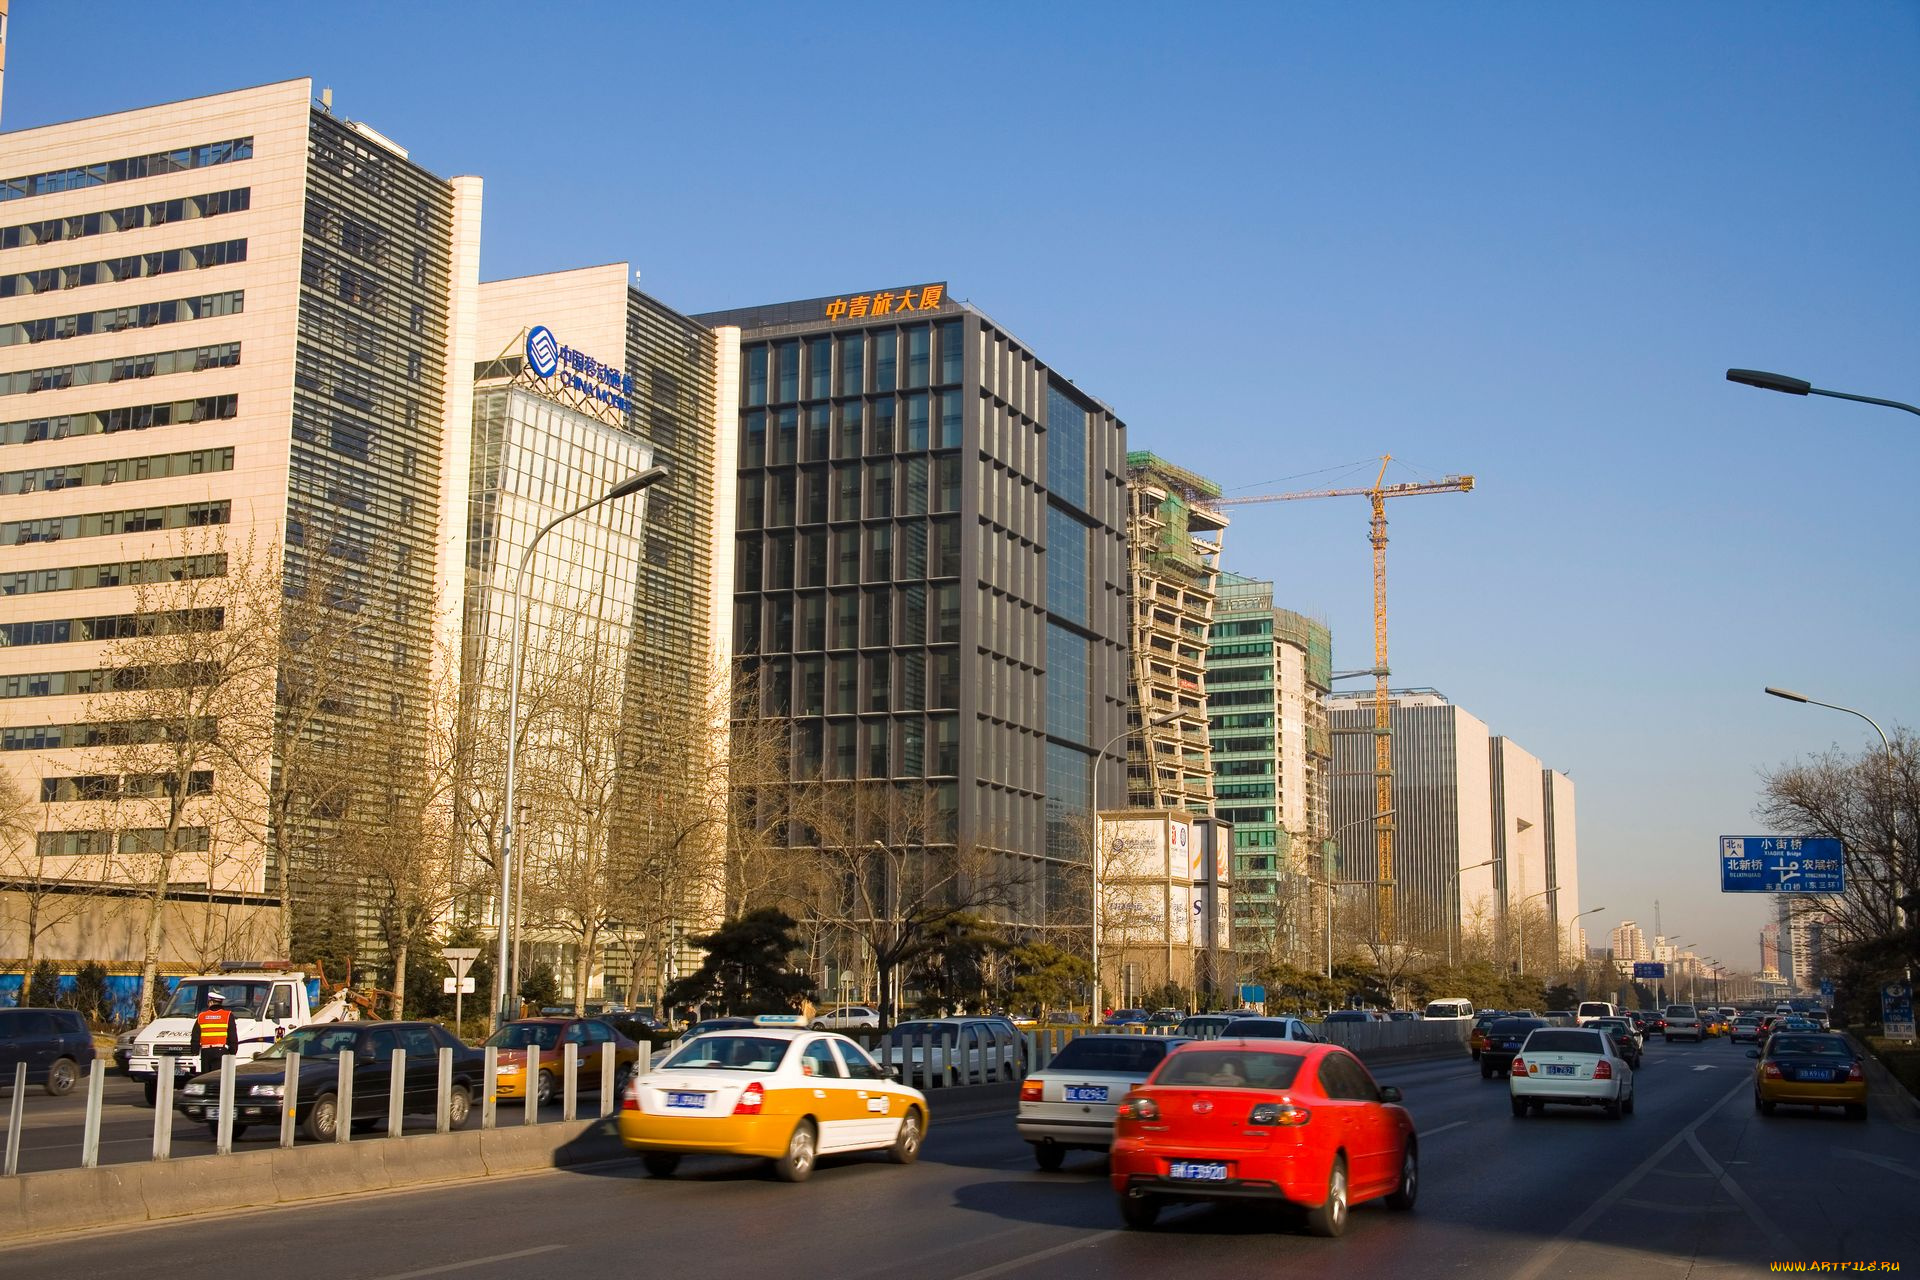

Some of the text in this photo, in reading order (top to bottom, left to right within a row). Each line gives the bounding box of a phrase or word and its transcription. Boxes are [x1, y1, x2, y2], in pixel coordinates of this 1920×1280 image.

[825, 285, 943, 321] 中青旅大厦
[560, 345, 633, 396] 中国移动通信
[560, 370, 632, 414] CHINA MOBILE
[1726, 840, 1736, 849] 北
[1761, 838, 1802, 850] 小街桥
[1728, 859, 1763, 871] 北新桥
